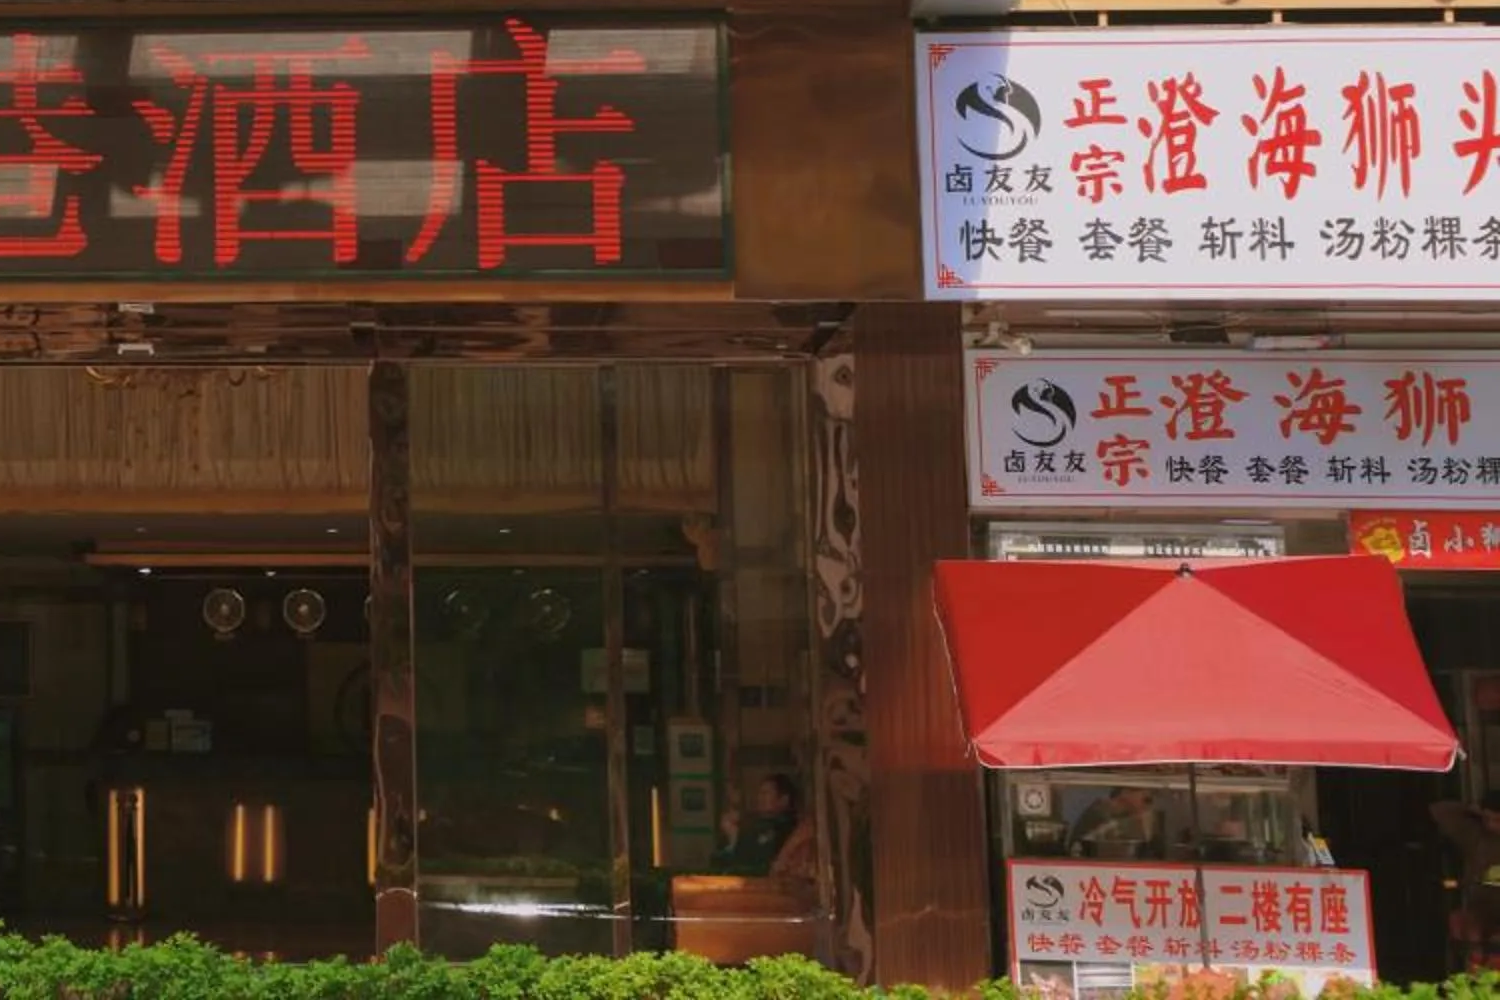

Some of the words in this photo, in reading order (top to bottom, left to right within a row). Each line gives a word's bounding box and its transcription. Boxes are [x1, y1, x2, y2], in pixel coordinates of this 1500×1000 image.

[1063, 78, 1128, 203] 正宗
[946, 164, 1054, 193] 卤友友
[959, 218, 1054, 263] 快餐
[1079, 216, 1173, 263] 套餐
[1201, 215, 1295, 261] 斩料
[1090, 374, 1152, 487] 正宗
[1158, 366, 1473, 448] 澄海狮
[1004, 449, 1087, 473] 卤友友
[1165, 455, 1229, 486] 快餐
[1245, 455, 1310, 486] 套餐
[1326, 455, 1392, 486] 斩料
[1219, 879, 1351, 935] 二楼有座
